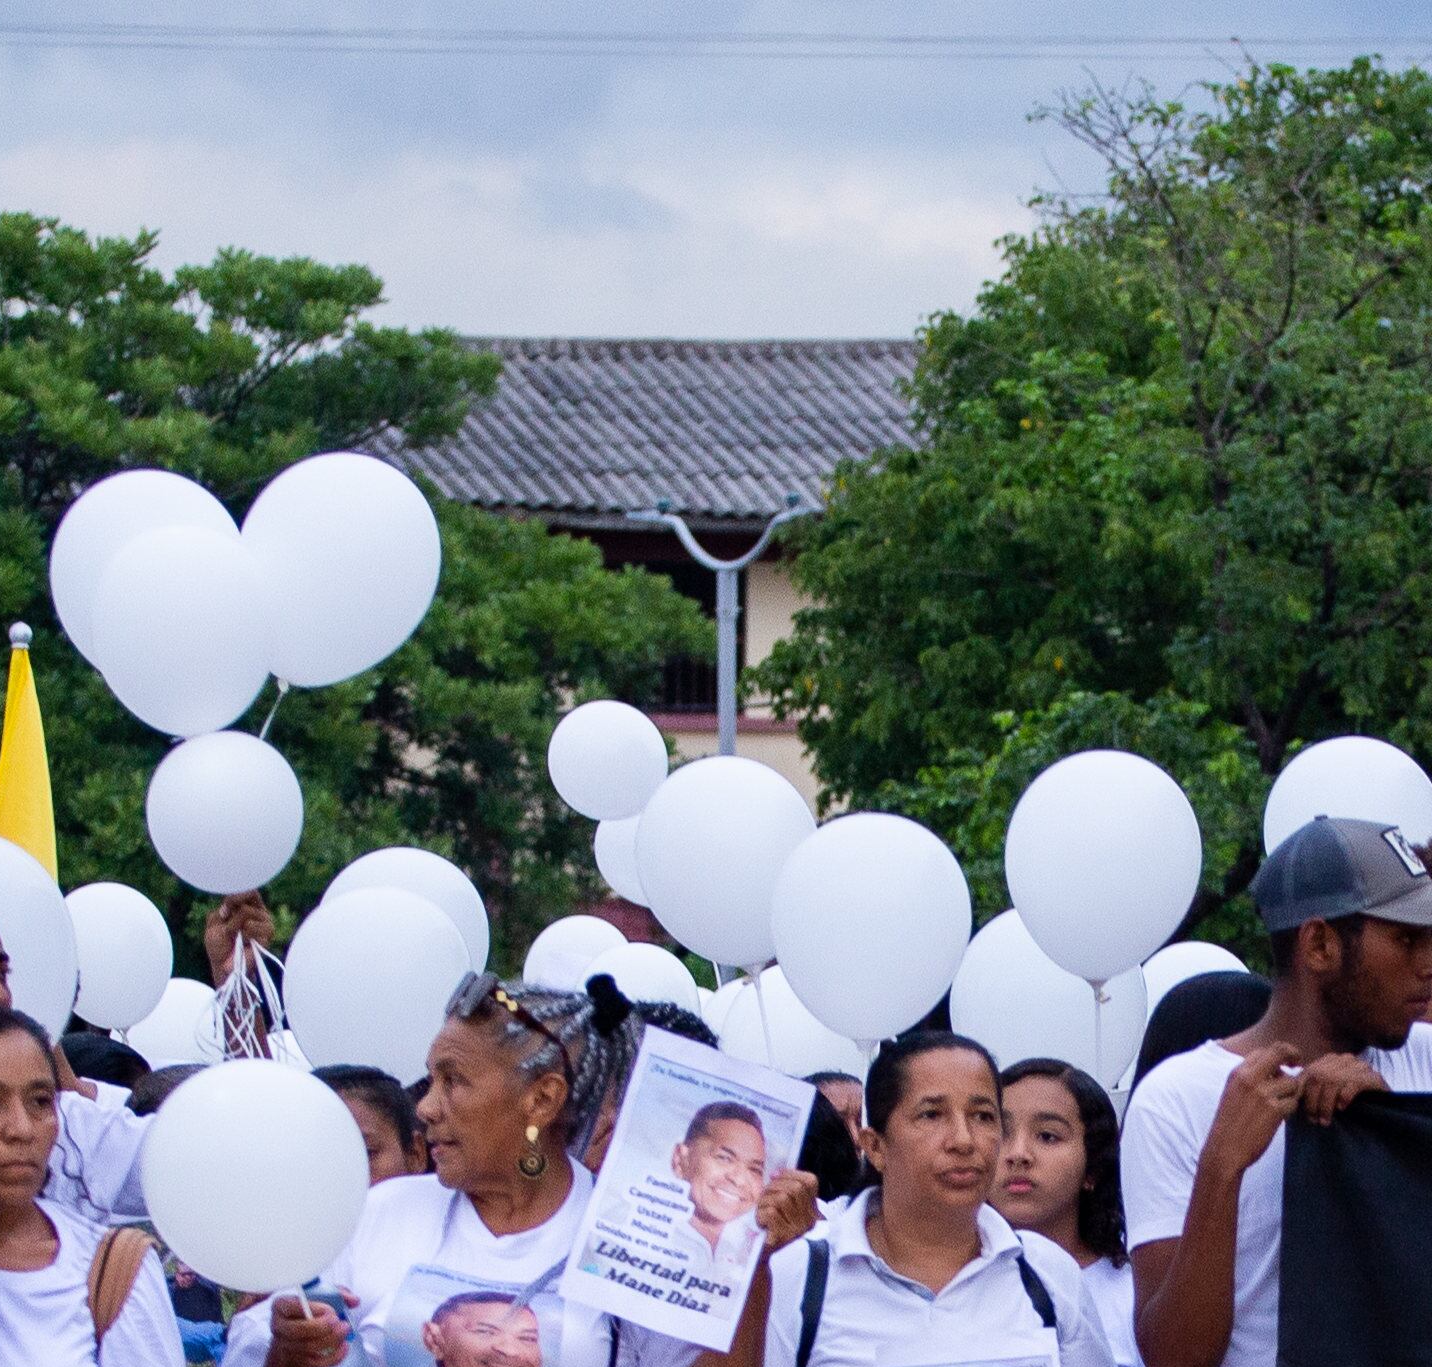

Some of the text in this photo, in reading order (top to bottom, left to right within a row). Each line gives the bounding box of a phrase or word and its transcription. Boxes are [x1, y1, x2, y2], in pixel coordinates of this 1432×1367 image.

[629, 1186, 689, 1212] Campuzano
[646, 1175, 684, 1194] Familia
[596, 1241, 686, 1283] Libertad
[684, 1275, 731, 1298] para
[604, 1267, 711, 1314] Mane Díaz
